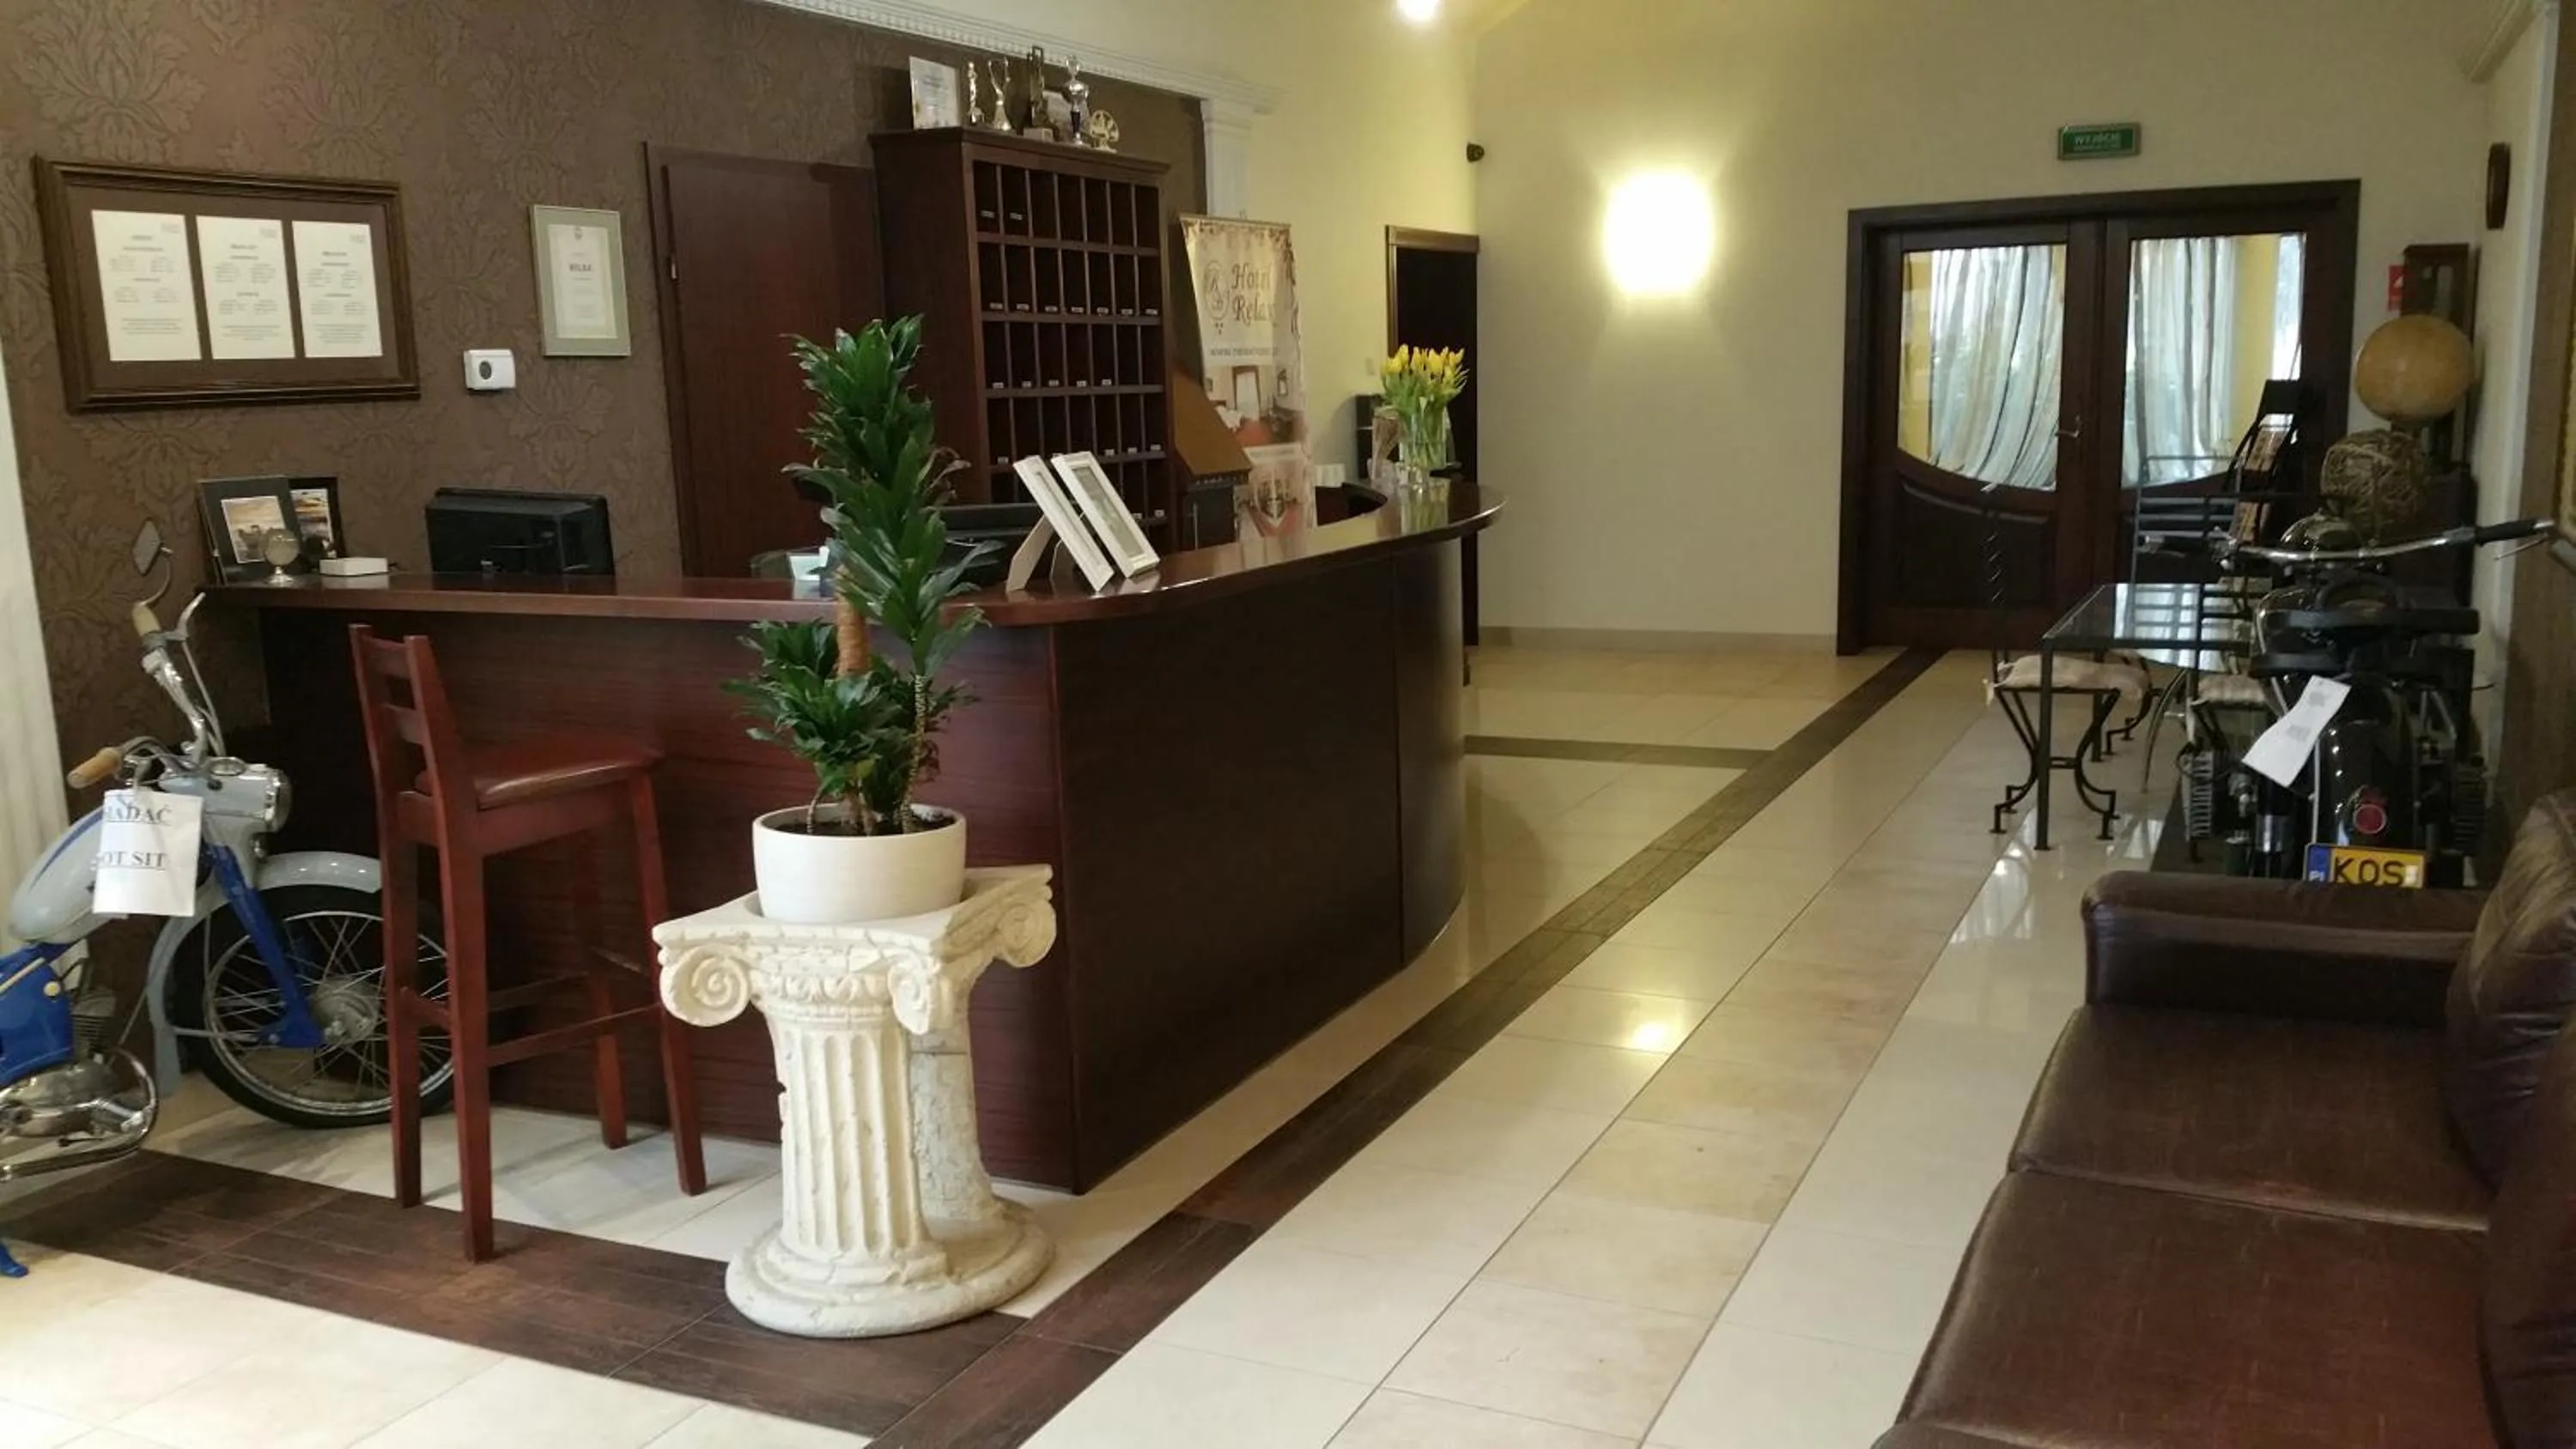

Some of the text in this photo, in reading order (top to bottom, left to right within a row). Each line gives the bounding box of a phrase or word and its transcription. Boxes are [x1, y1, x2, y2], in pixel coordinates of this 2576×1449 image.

[1231, 263, 1271, 289] Hotel
[1232, 294, 1275, 326] Relax
[132, 851, 167, 867] SIT
[2335, 858, 2404, 886] KOS
